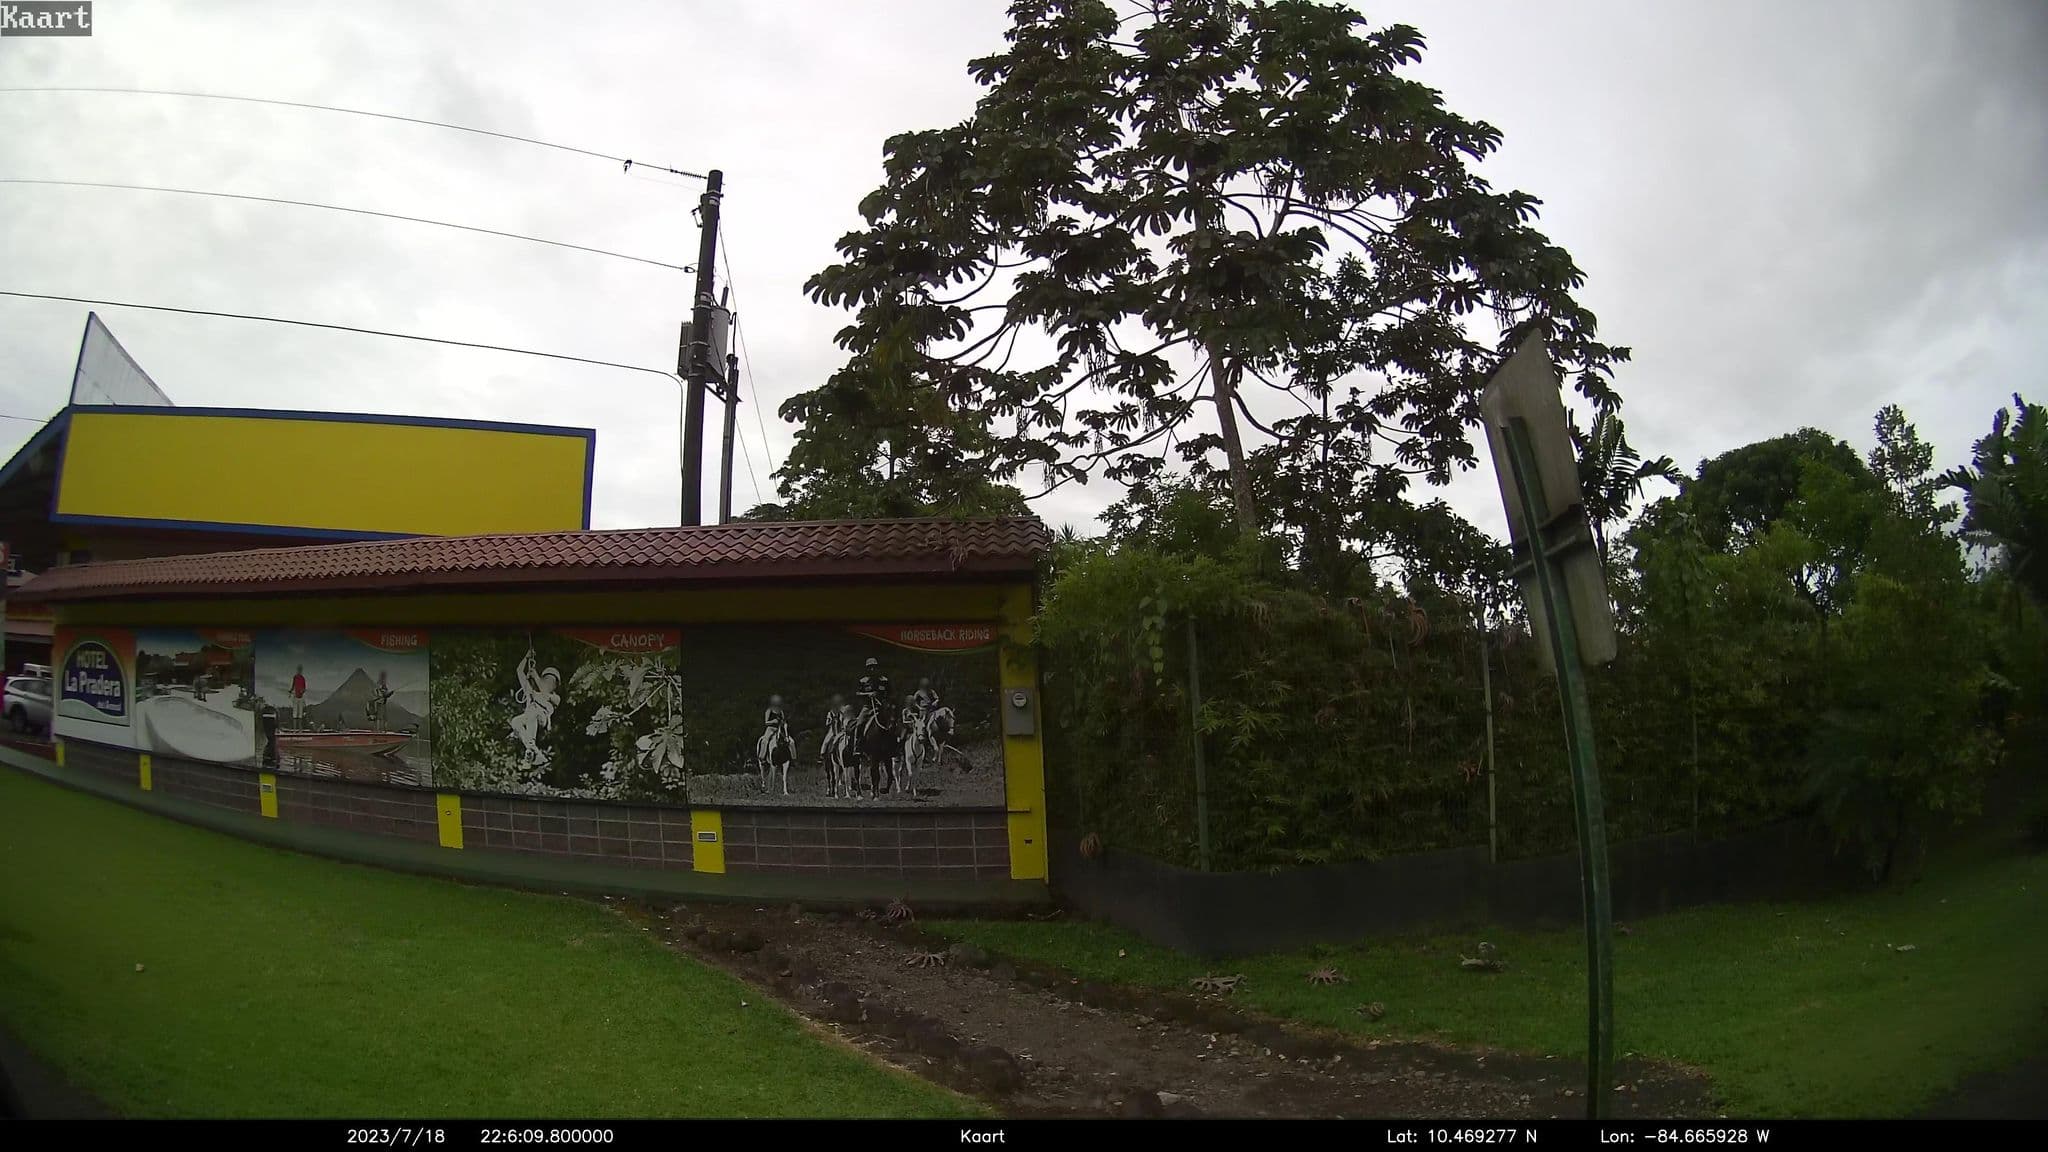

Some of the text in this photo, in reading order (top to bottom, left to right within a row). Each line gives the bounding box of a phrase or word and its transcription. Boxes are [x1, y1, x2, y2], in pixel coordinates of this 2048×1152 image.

[380, 632, 418, 646] FISHING
[610, 633, 665, 648] CANOPY
[900, 628, 991, 642] HORSEBACK RIDING
[76, 650, 109, 669] HOTEL
[65, 670, 121, 697] La Pradera
